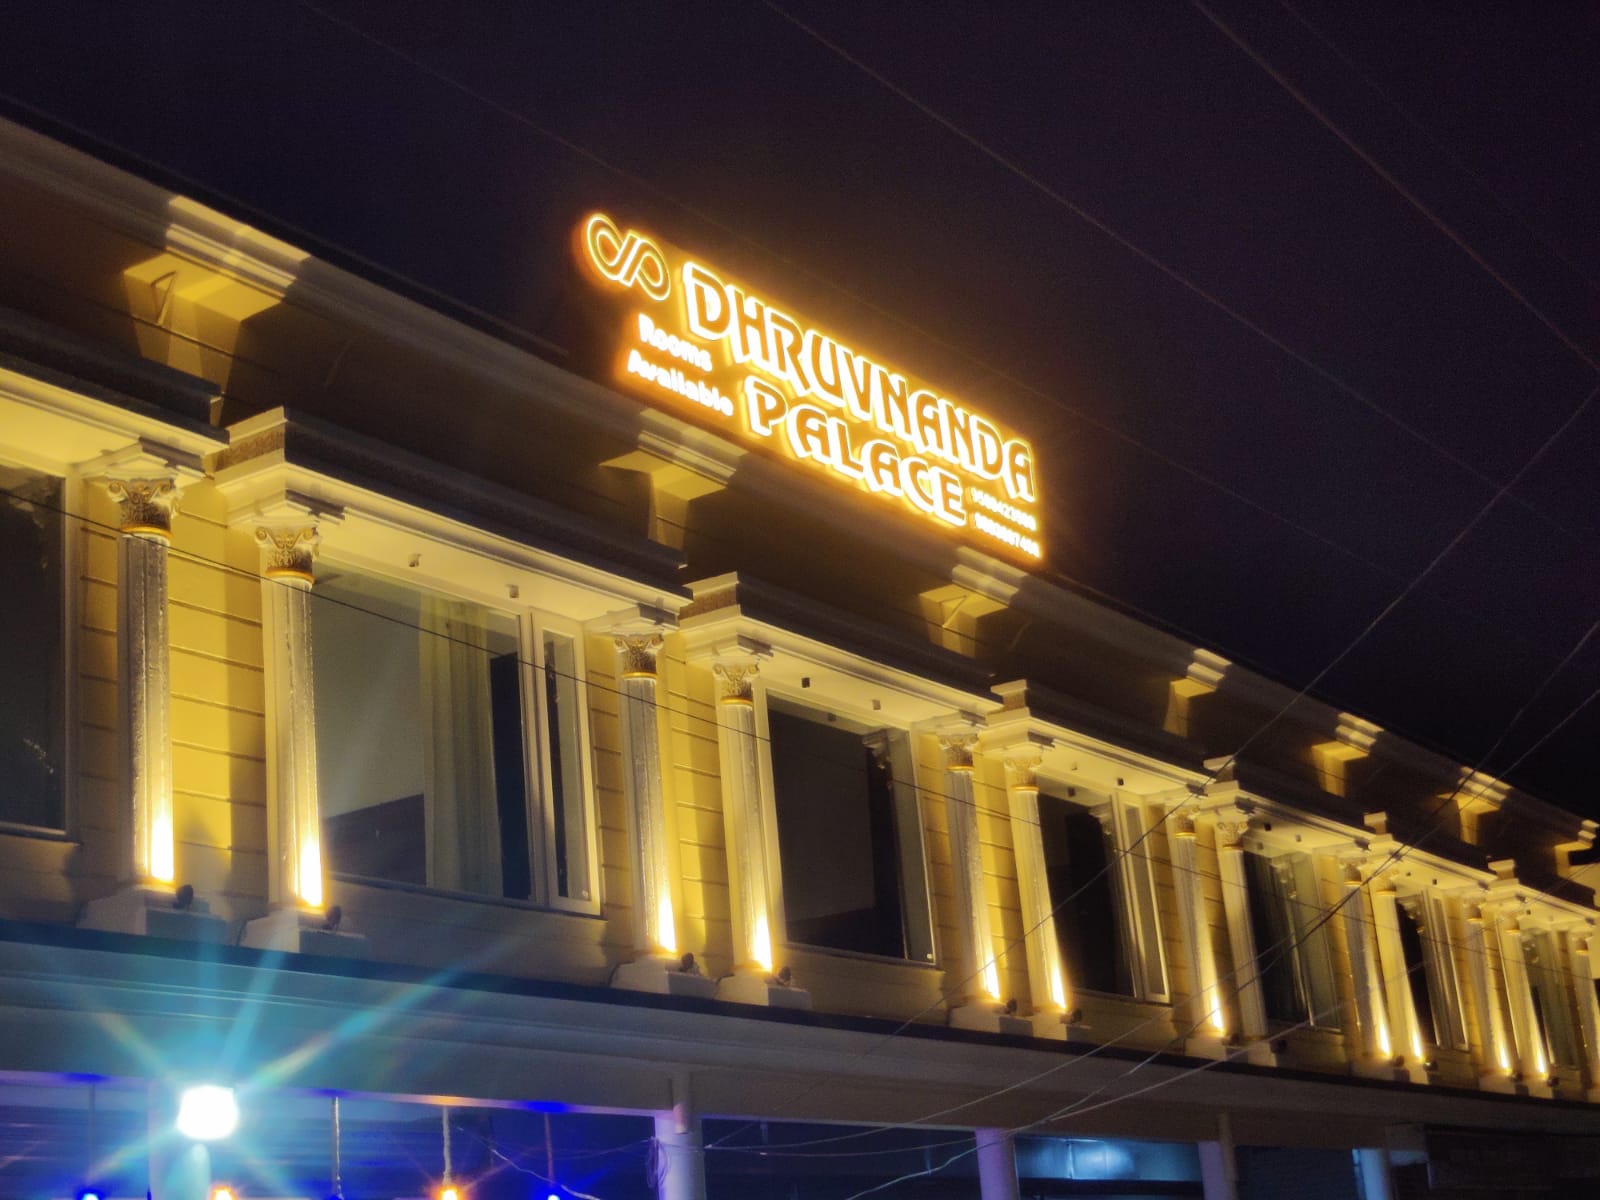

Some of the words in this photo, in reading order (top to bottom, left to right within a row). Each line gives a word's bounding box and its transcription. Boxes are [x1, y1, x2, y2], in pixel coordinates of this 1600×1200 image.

[627, 348, 734, 418] Available
[636, 312, 713, 373] Rooms
[682, 261, 1036, 503] DHRUVNANDA
[745, 376, 967, 527] PALACE
